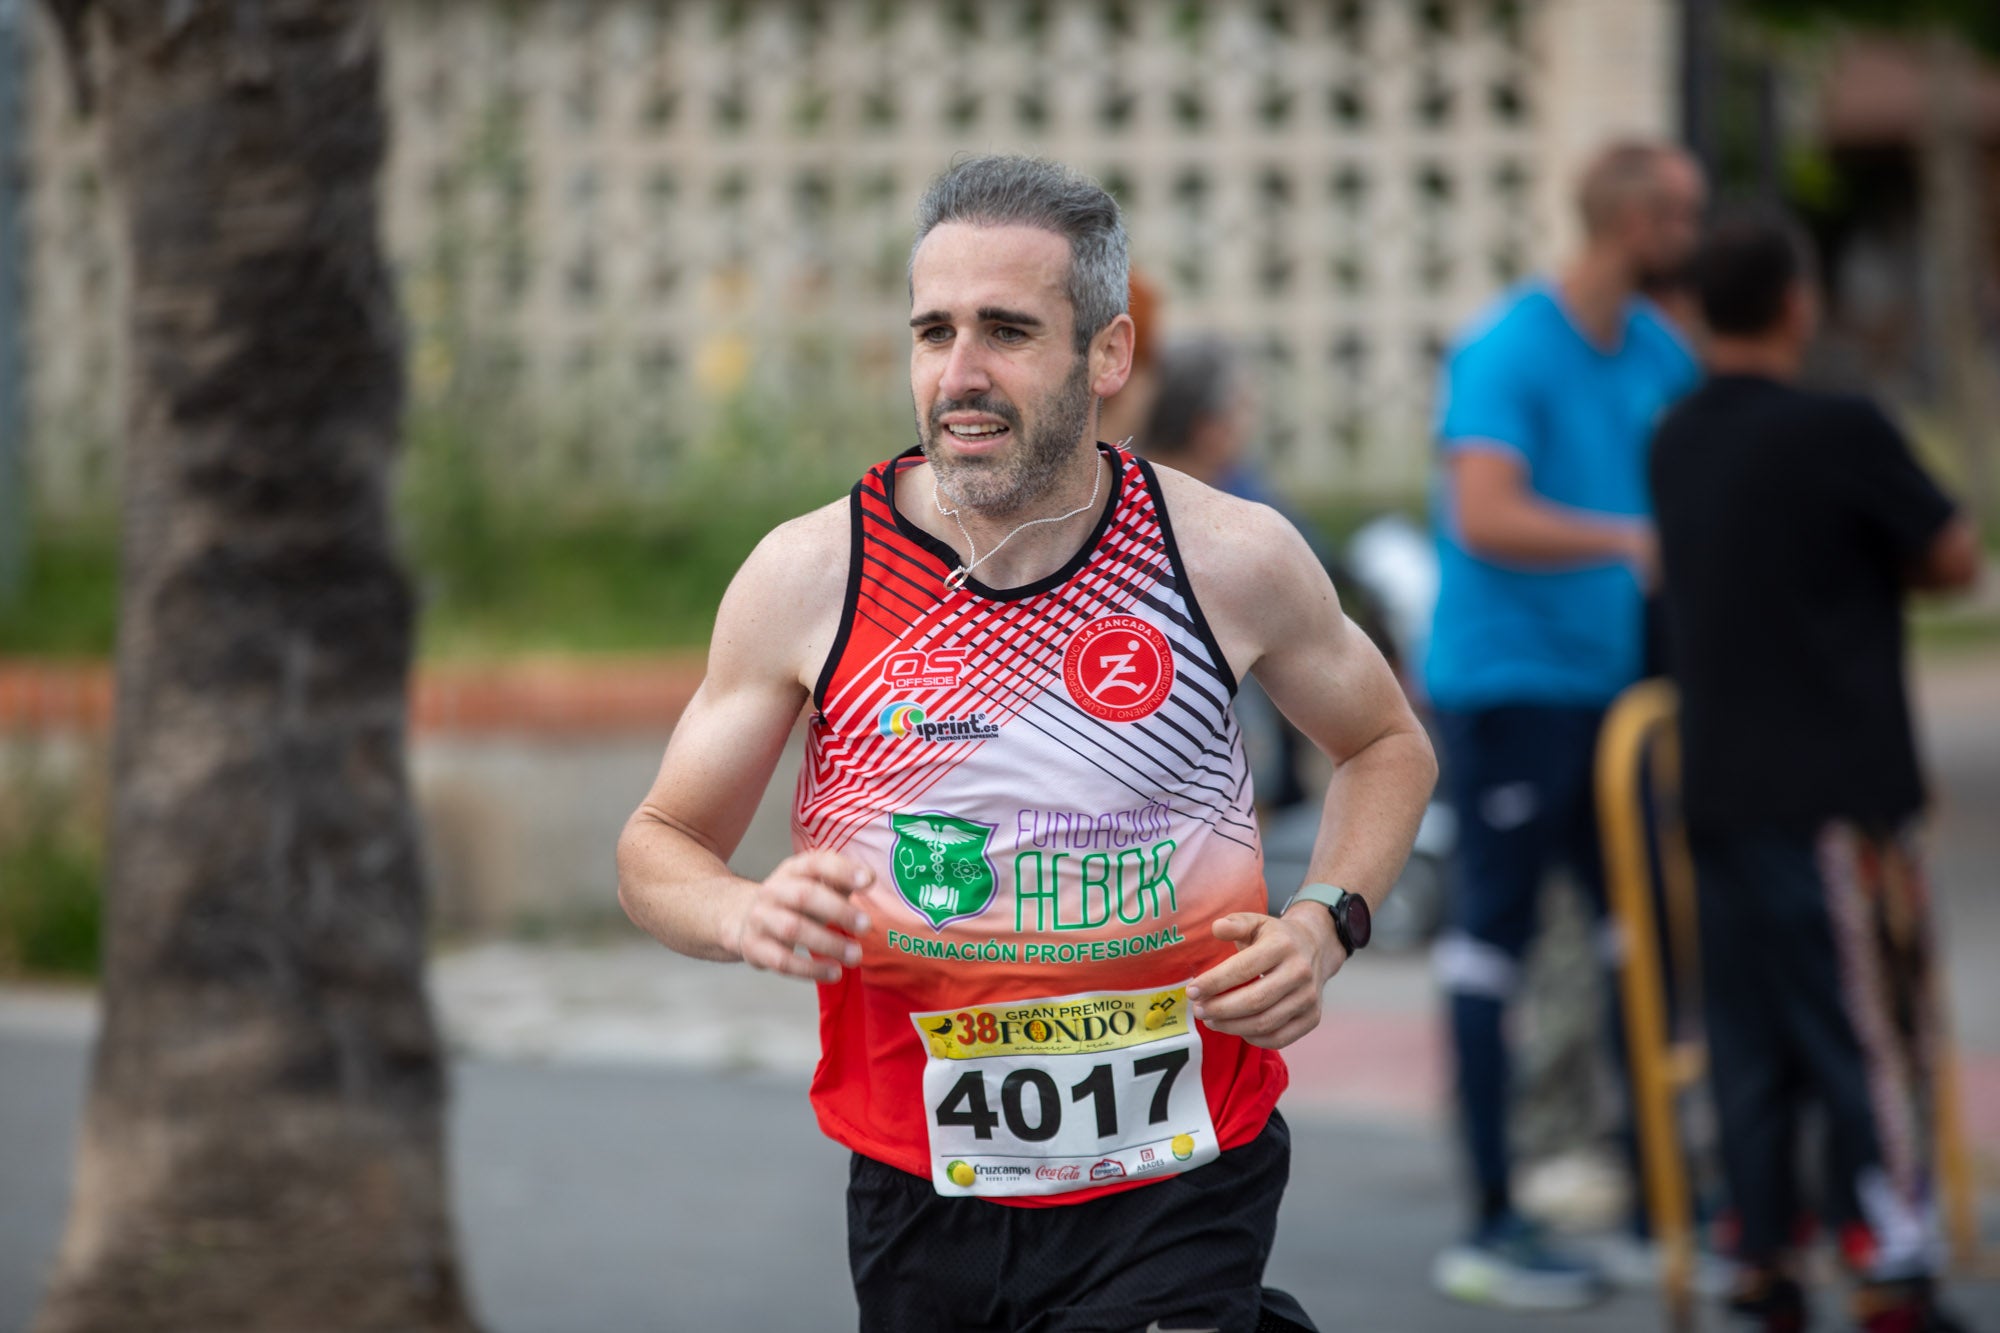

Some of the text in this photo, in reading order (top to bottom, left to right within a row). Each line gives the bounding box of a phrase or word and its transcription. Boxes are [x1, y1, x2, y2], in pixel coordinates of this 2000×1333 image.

[1067, 618, 1172, 719] CLUB DEPORTIVO LA ZANCADA DE TORREDONJIMENO
[896, 675, 955, 688] OFFSIDE
[1015, 797, 1172, 849] FUNDACIÓN
[888, 925, 1185, 963] FORMACIÓN PROFESIONAL
[1006, 1000, 1136, 1020] GRAN PREMIO DE
[956, 1010, 1136, 1046] 38 FONDO
[1031, 1022, 1041, 1031] 20
[1034, 1031, 1045, 1040] 25
[935, 1047, 1190, 1142] 4017
[973, 1164, 1031, 1179] Cruzcampo
[1035, 1165, 1082, 1181] Coca-Cola
[1137, 1159, 1165, 1172] ABADES
